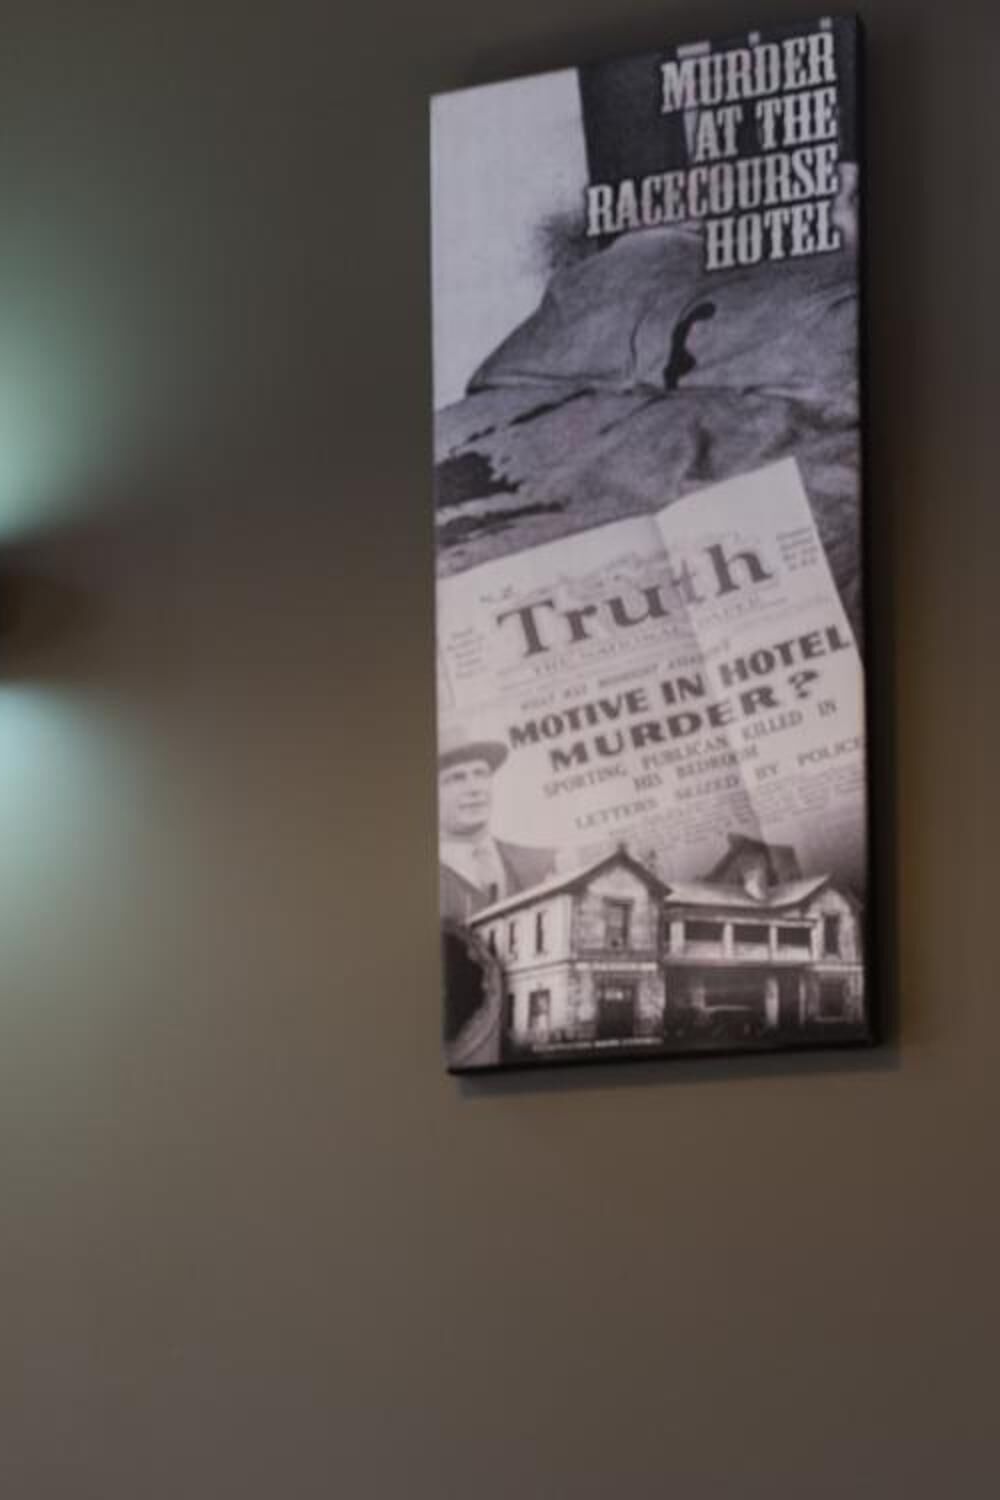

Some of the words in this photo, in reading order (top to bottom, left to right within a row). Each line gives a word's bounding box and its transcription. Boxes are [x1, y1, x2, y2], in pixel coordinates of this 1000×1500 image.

[661, 31, 837, 114] MURDER
[695, 105, 743, 162] AT
[756, 86, 838, 150] THE
[586, 143, 839, 237] RACECOURSE
[706, 200, 841, 271] HOTEL
[496, 543, 773, 658] Truth
[508, 686, 650, 750] MOTIVE
[660, 672, 706, 705] IN
[719, 623, 851, 688] HOTEL
[816, 700, 838, 718] IN
